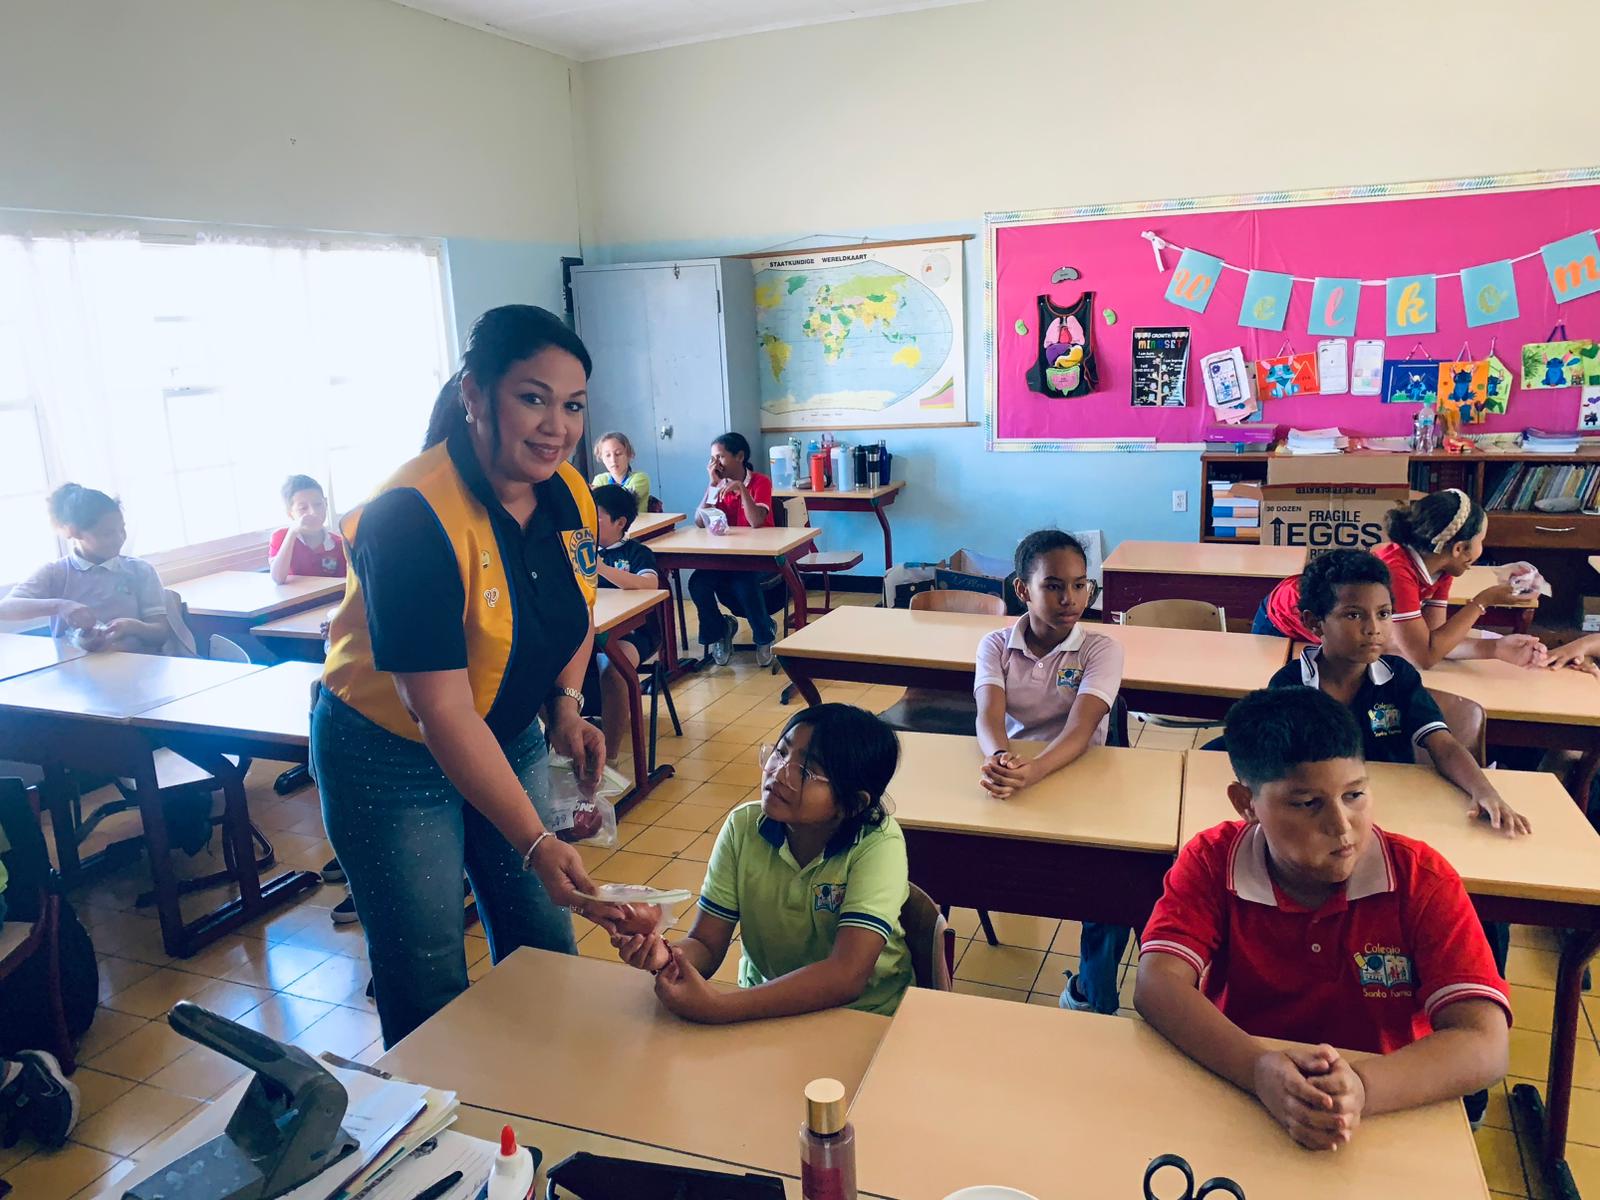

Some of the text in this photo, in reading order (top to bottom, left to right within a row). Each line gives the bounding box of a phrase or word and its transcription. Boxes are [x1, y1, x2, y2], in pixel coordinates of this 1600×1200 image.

[769, 253, 868, 268] STAATKUNDIGE WERELDKAART
[1308, 510, 1361, 522] FRAGILE
[1286, 522, 1383, 547] EGGS
[1364, 943, 1401, 954] Colegio
